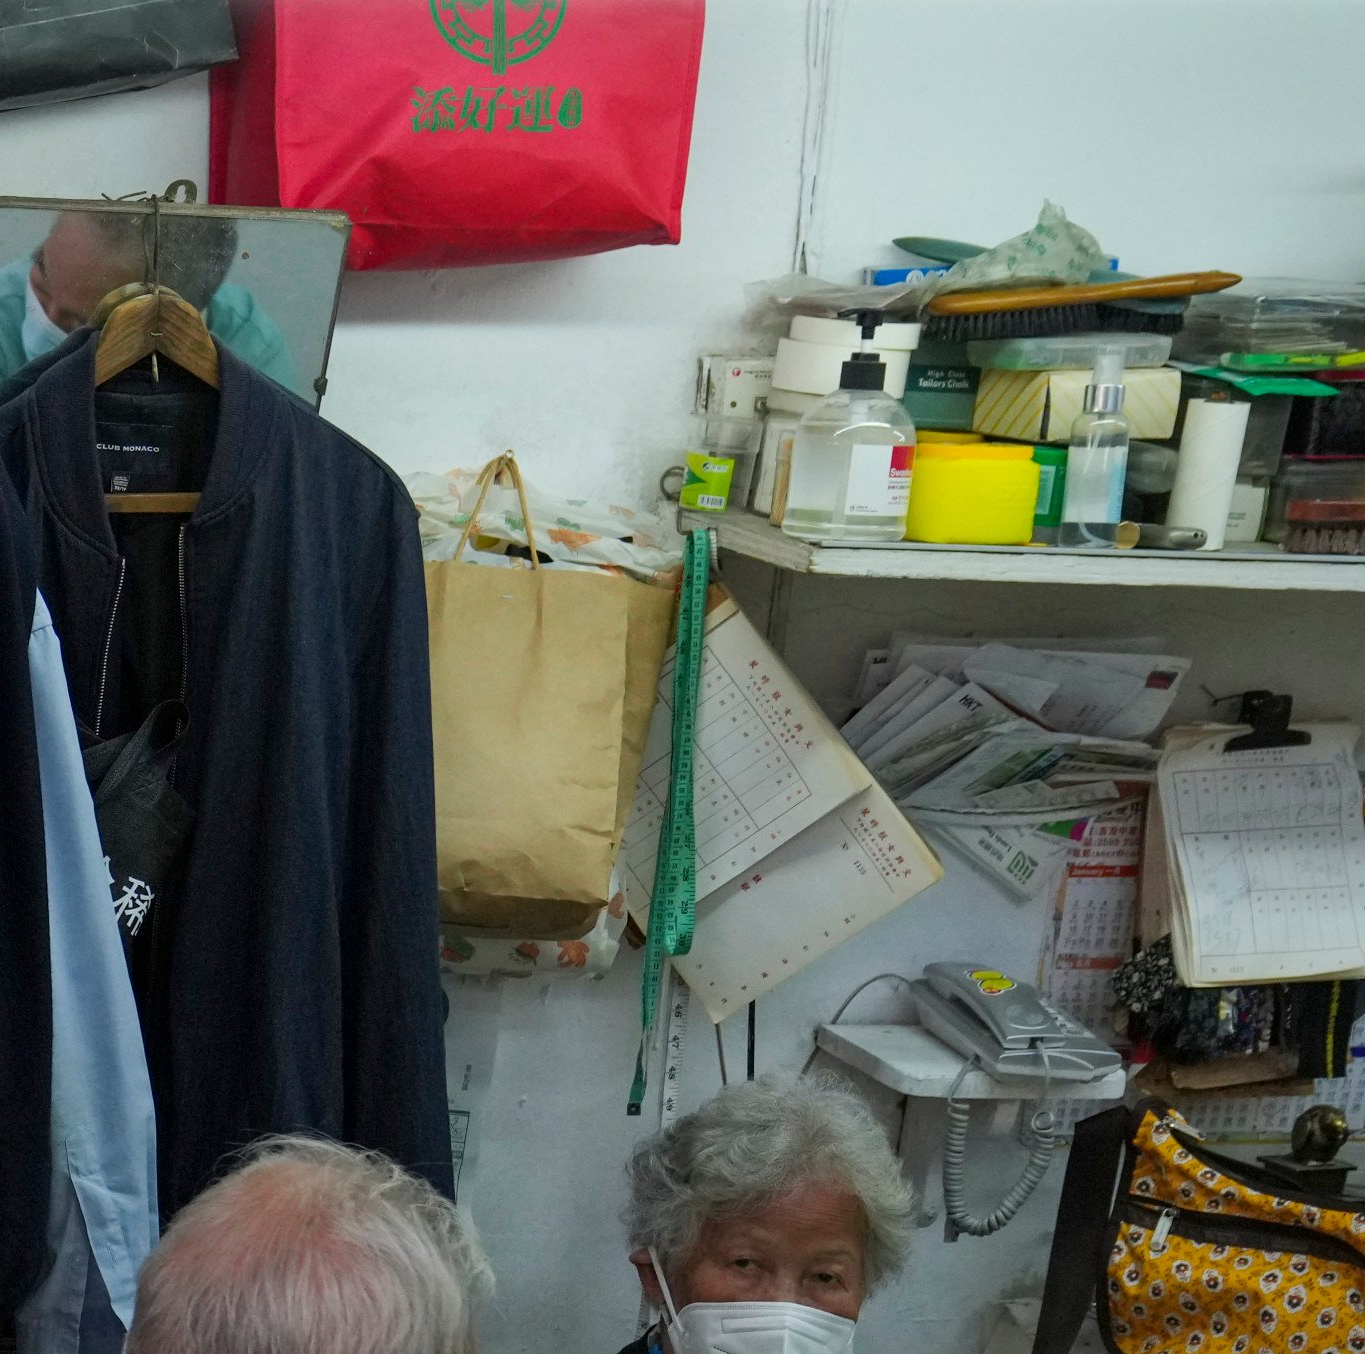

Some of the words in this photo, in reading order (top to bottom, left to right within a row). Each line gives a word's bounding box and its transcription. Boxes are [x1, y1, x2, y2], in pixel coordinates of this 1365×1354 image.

[409, 86, 554, 133] 添好運
[918, 378, 946, 388] Tailors
[948, 378, 970, 388] Chalk
[95, 442, 121, 451] CLUB
[122, 445, 160, 453] MONACO
[958, 694, 983, 711] HKT
[1072, 867, 1104, 877] January
[106, 860, 154, 935] 稀
[674, 1003, 682, 1018] 46
[671, 1034, 679, 1049] 47
[668, 1065, 676, 1080] 48
